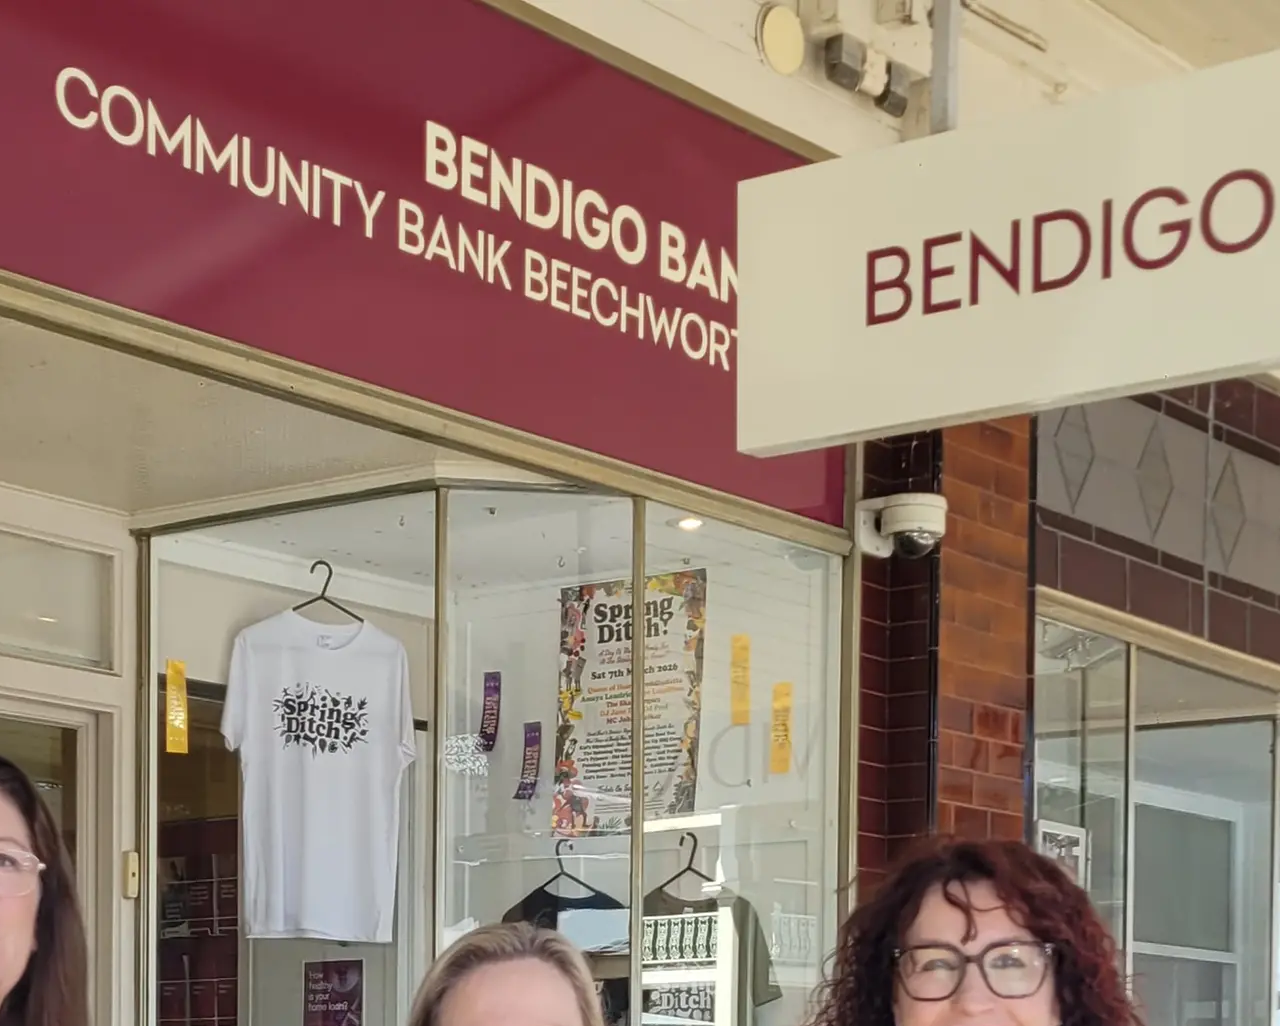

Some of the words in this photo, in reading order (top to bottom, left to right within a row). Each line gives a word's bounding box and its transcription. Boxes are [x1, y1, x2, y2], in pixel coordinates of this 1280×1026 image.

[56, 67, 385, 238] COMMUNITY
[398, 199, 512, 290] BANK
[524, 248, 738, 371] BEECHWOR
[425, 120, 648, 266] BENDIGO
[660, 220, 738, 304] BAN
[866, 168, 1275, 327] BENDIGO
[594, 597, 674, 624] Sprng
[597, 618, 669, 644] Dith!
[283, 698, 356, 730] Spring
